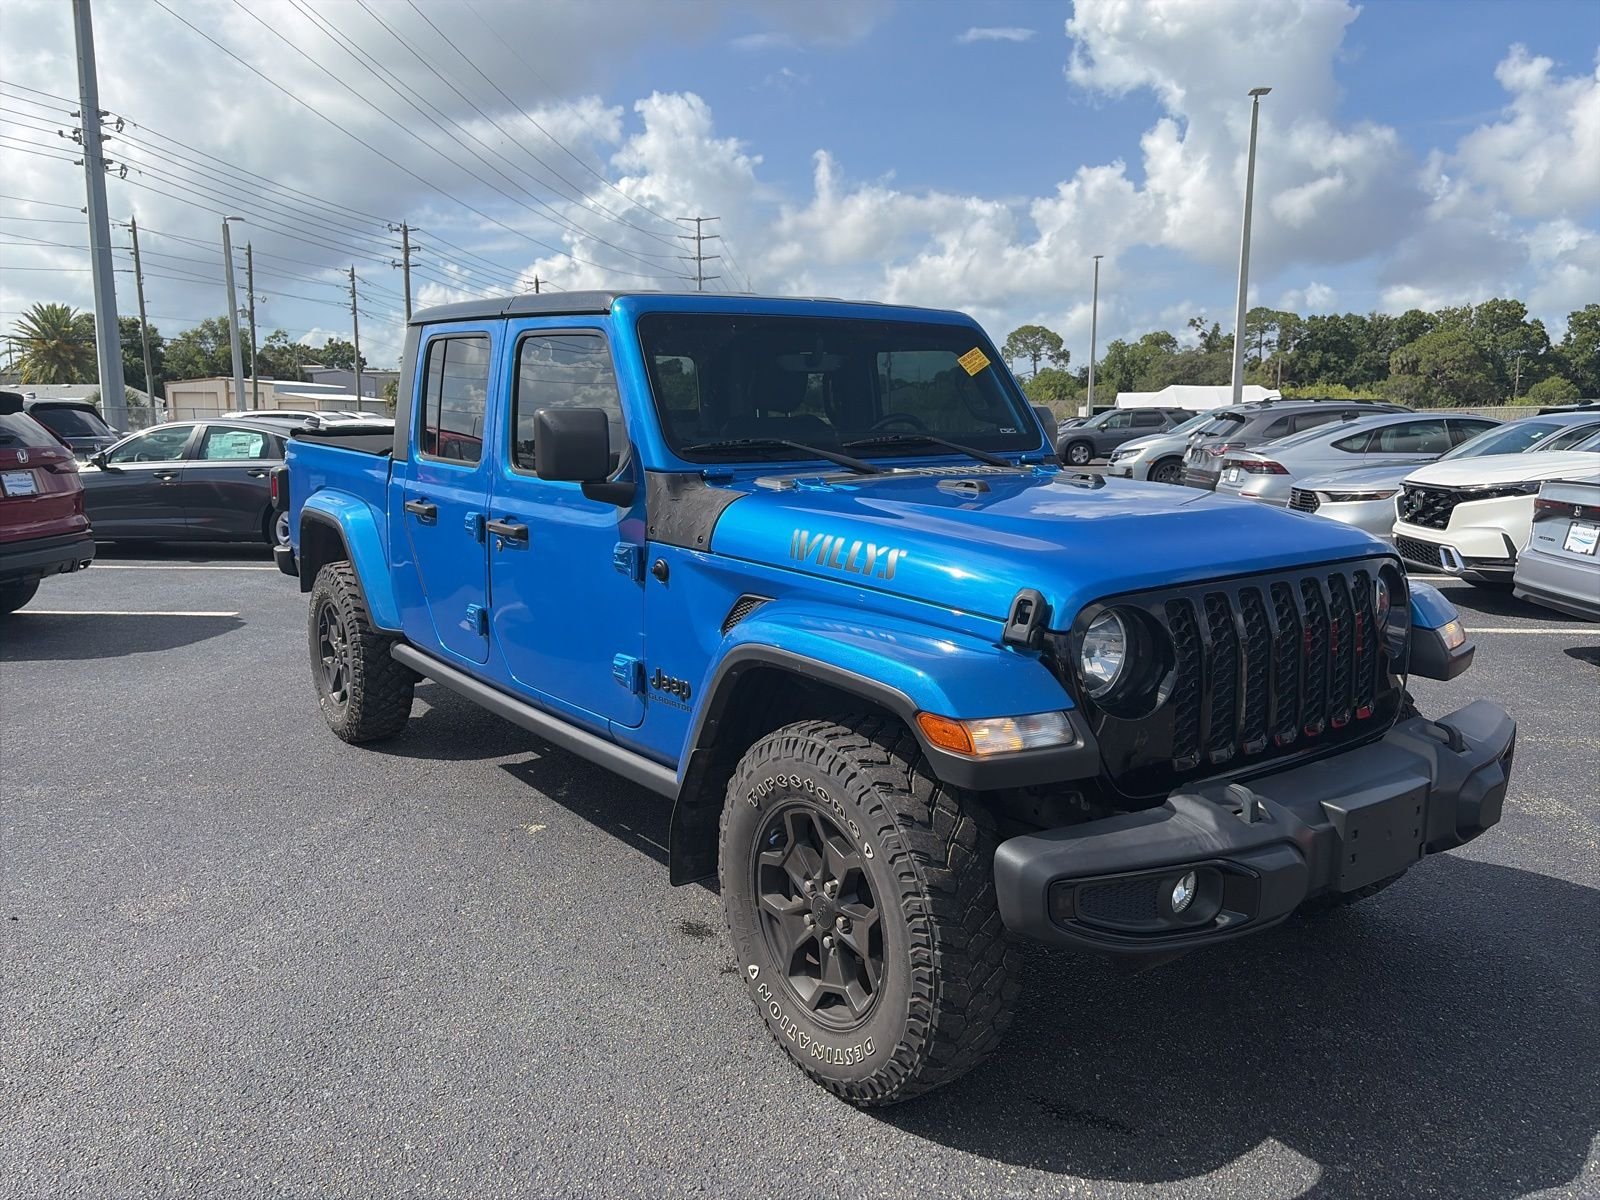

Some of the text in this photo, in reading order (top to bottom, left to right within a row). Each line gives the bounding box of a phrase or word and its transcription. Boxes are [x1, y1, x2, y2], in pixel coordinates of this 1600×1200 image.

[790, 528, 908, 580] WILLYS
[650, 667, 692, 702] Jeep
[747, 774, 860, 839] Firestone
[757, 983, 876, 1065] DESTINATION
